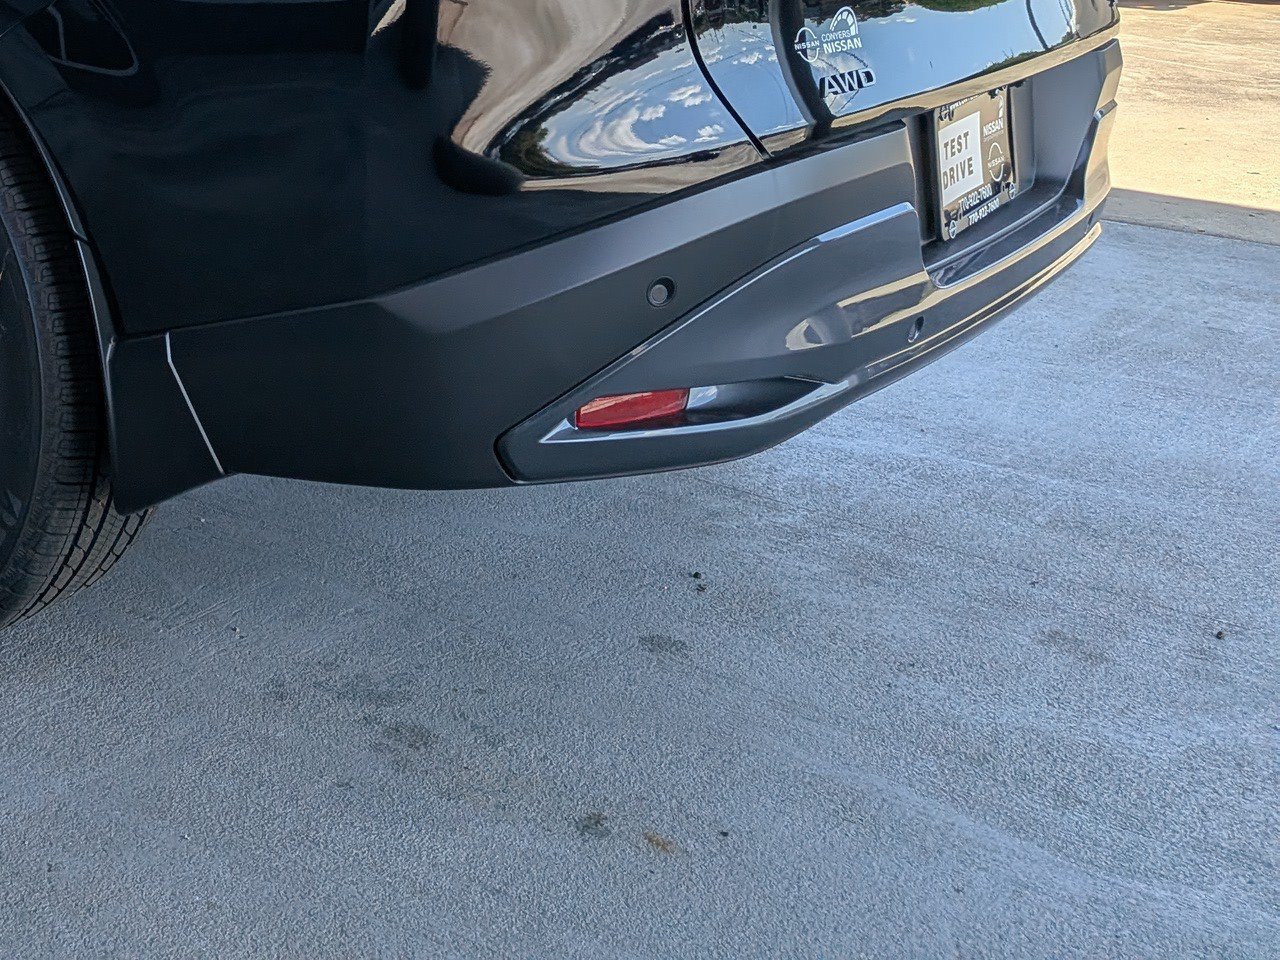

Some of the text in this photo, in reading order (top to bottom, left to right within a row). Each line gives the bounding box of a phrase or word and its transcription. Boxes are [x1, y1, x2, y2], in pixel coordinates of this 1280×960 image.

[794, 40, 821, 51] NISSAN
[821, 29, 852, 43] CONYERS
[823, 37, 863, 55] NISSAN
[821, 67, 877, 100] AWD
[943, 130, 970, 161] TEST
[942, 156, 974, 191] DRIVE
